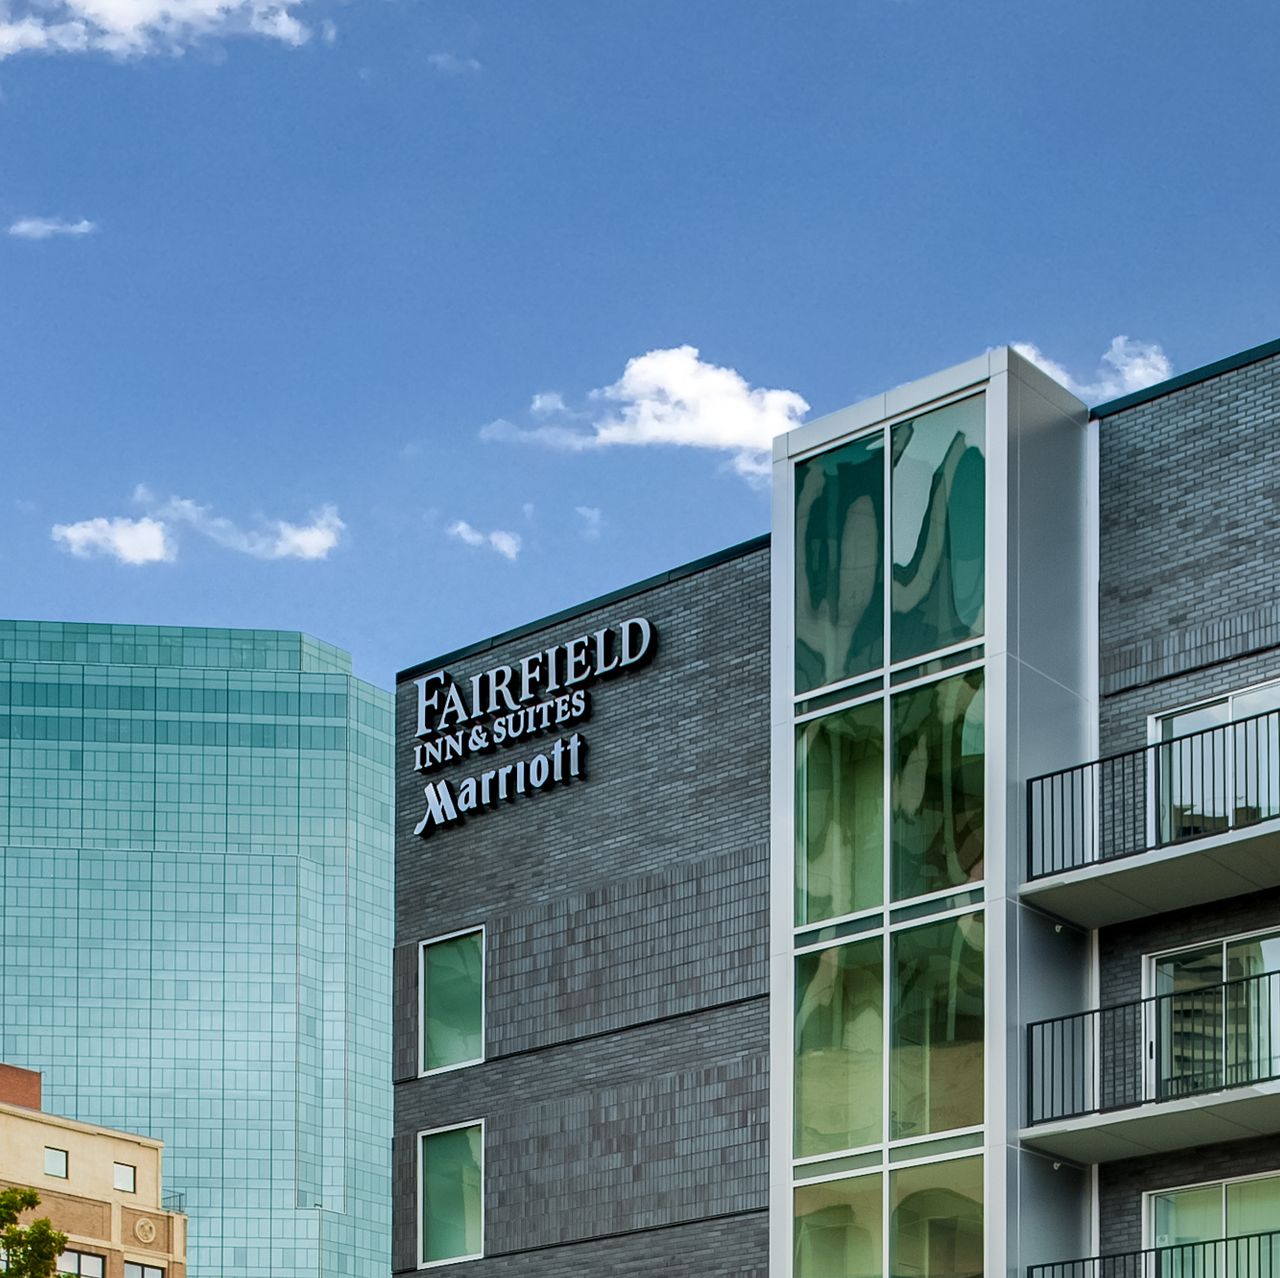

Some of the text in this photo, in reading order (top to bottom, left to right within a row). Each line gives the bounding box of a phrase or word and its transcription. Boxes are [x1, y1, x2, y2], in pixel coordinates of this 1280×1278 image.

[414, 617, 651, 738] FAIRFIELD
[414, 690, 586, 771] INN & SUITES
[413, 733, 581, 836] Marriott
